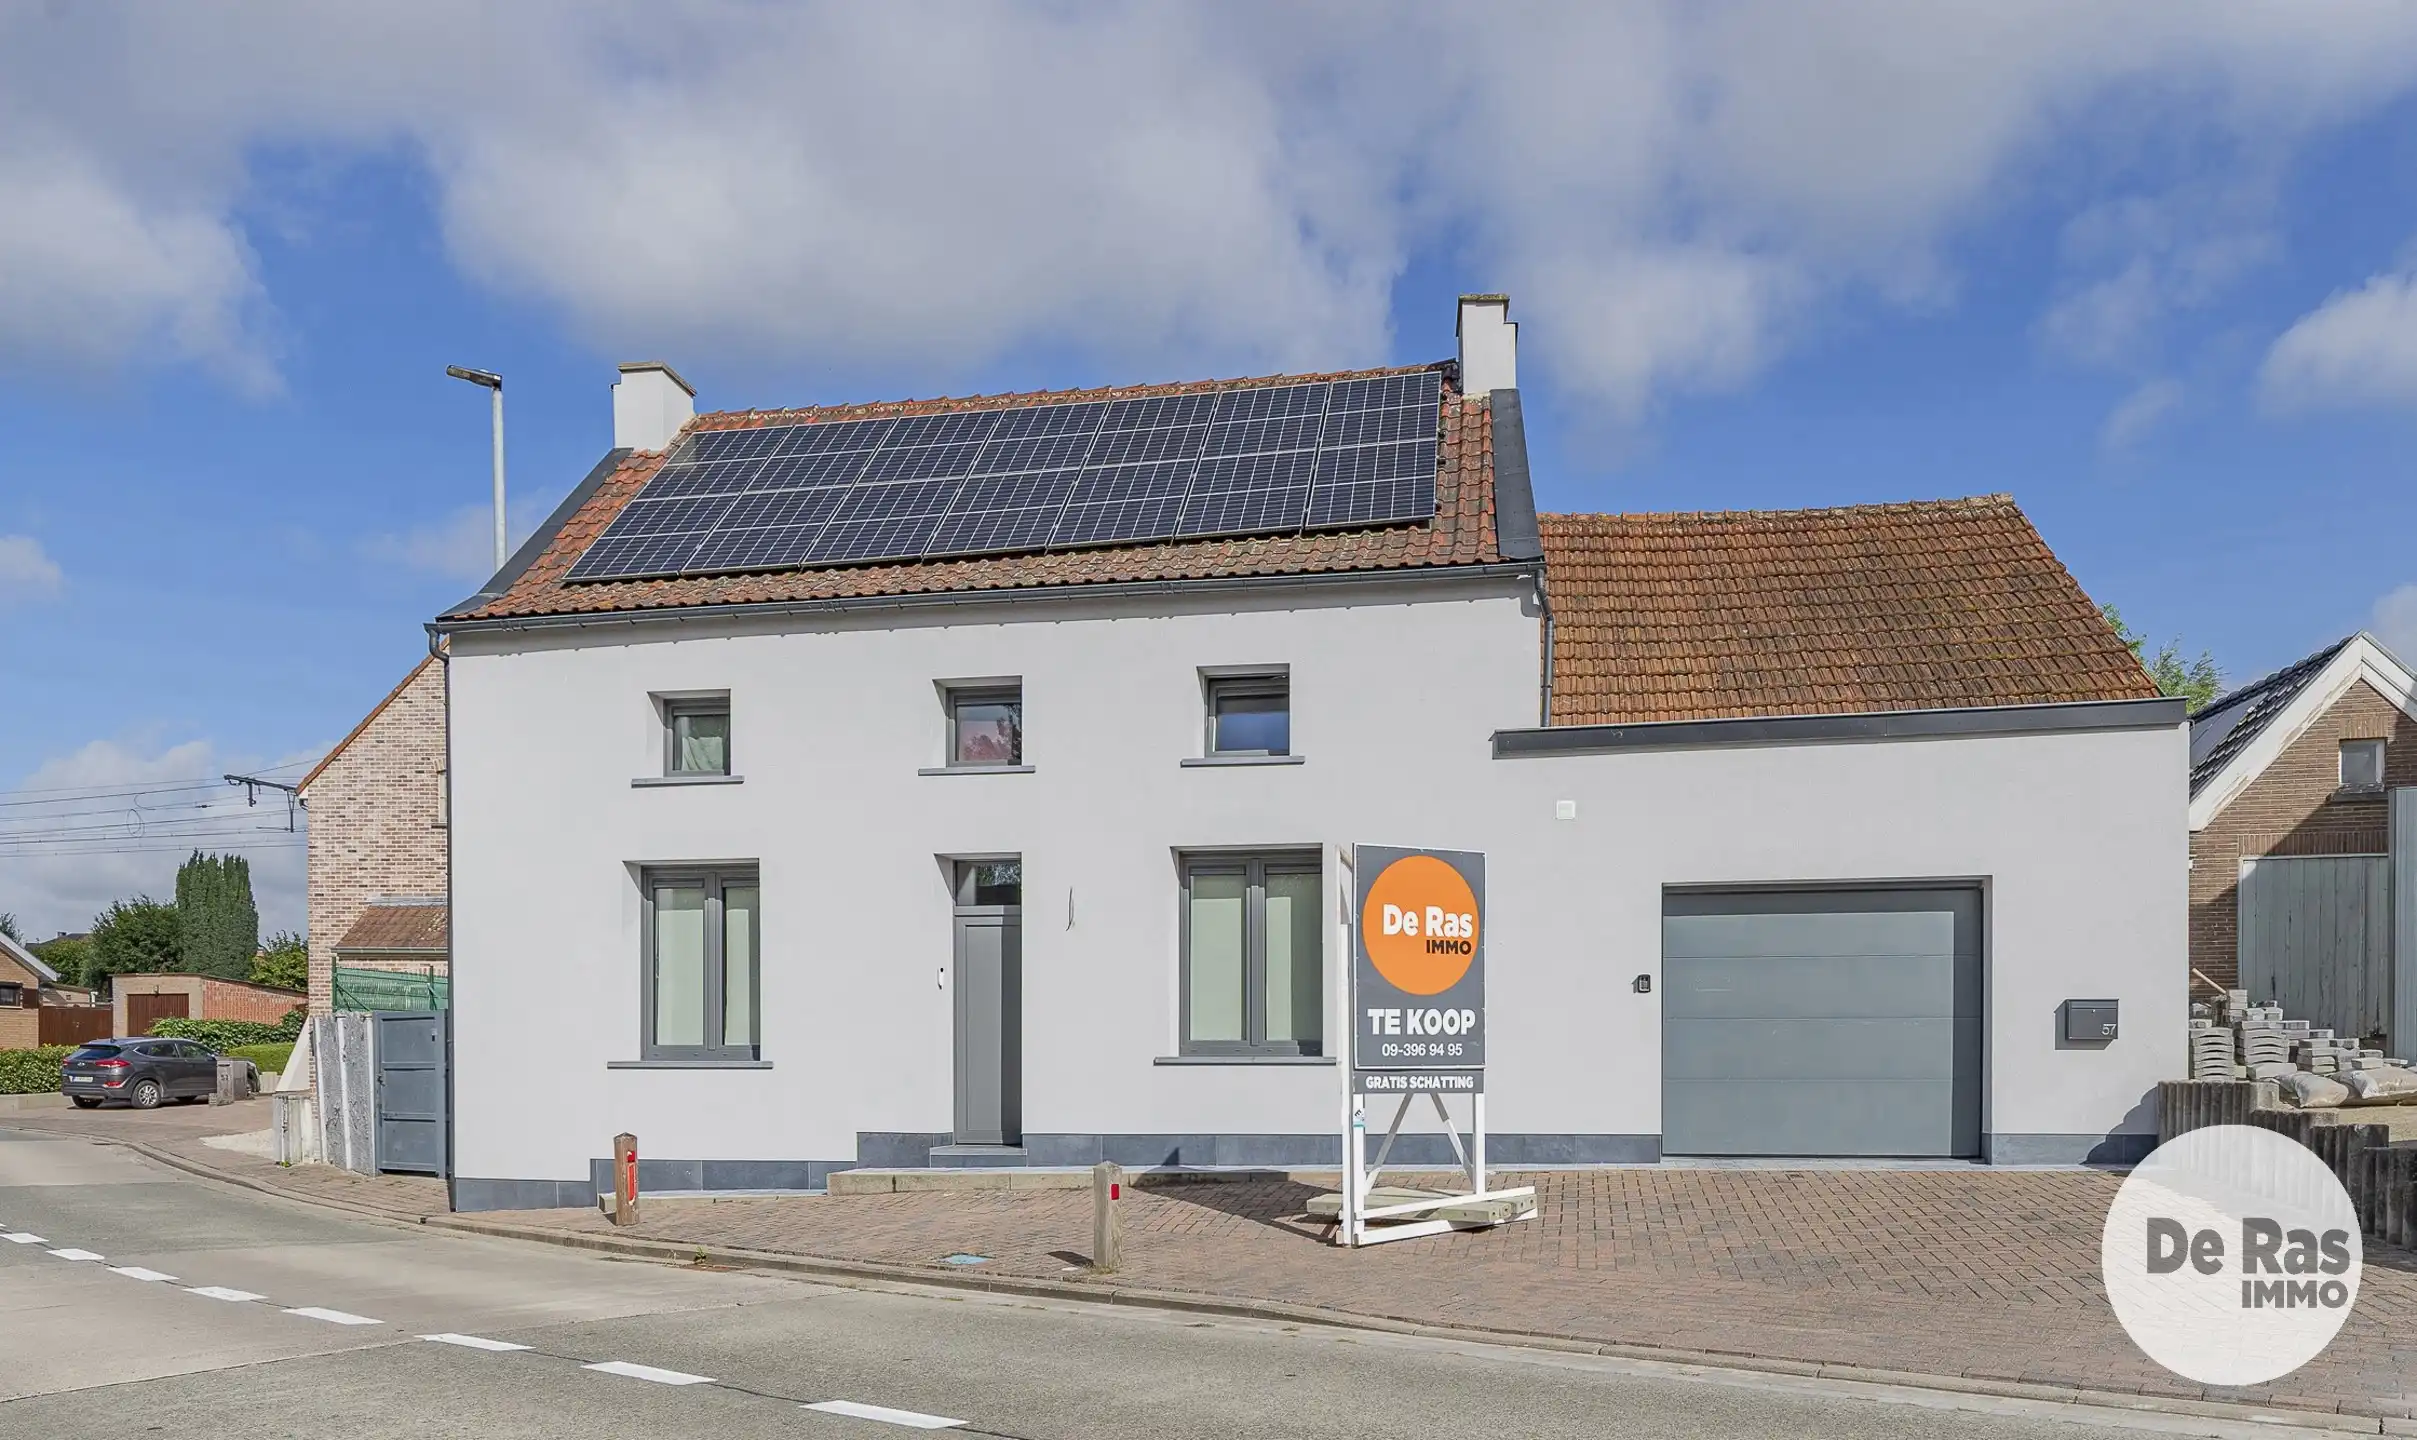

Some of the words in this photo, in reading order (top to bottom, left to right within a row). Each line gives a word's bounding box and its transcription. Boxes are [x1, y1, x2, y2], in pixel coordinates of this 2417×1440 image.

[1383, 904, 1418, 936] De
[1425, 906, 1472, 938] Ras
[1426, 940, 1471, 955] IMMO
[1367, 1008, 1400, 1035] TE
[1407, 1009, 1475, 1035] KOOP
[2102, 1023, 2116, 1035] 57
[1382, 1044, 1425, 1056] 09-396
[1429, 1043, 1444, 1056] 94
[1447, 1043, 1462, 1056] 95
[1366, 1076, 1407, 1089] GRATIS
[1410, 1076, 1473, 1089] SCHATTING
